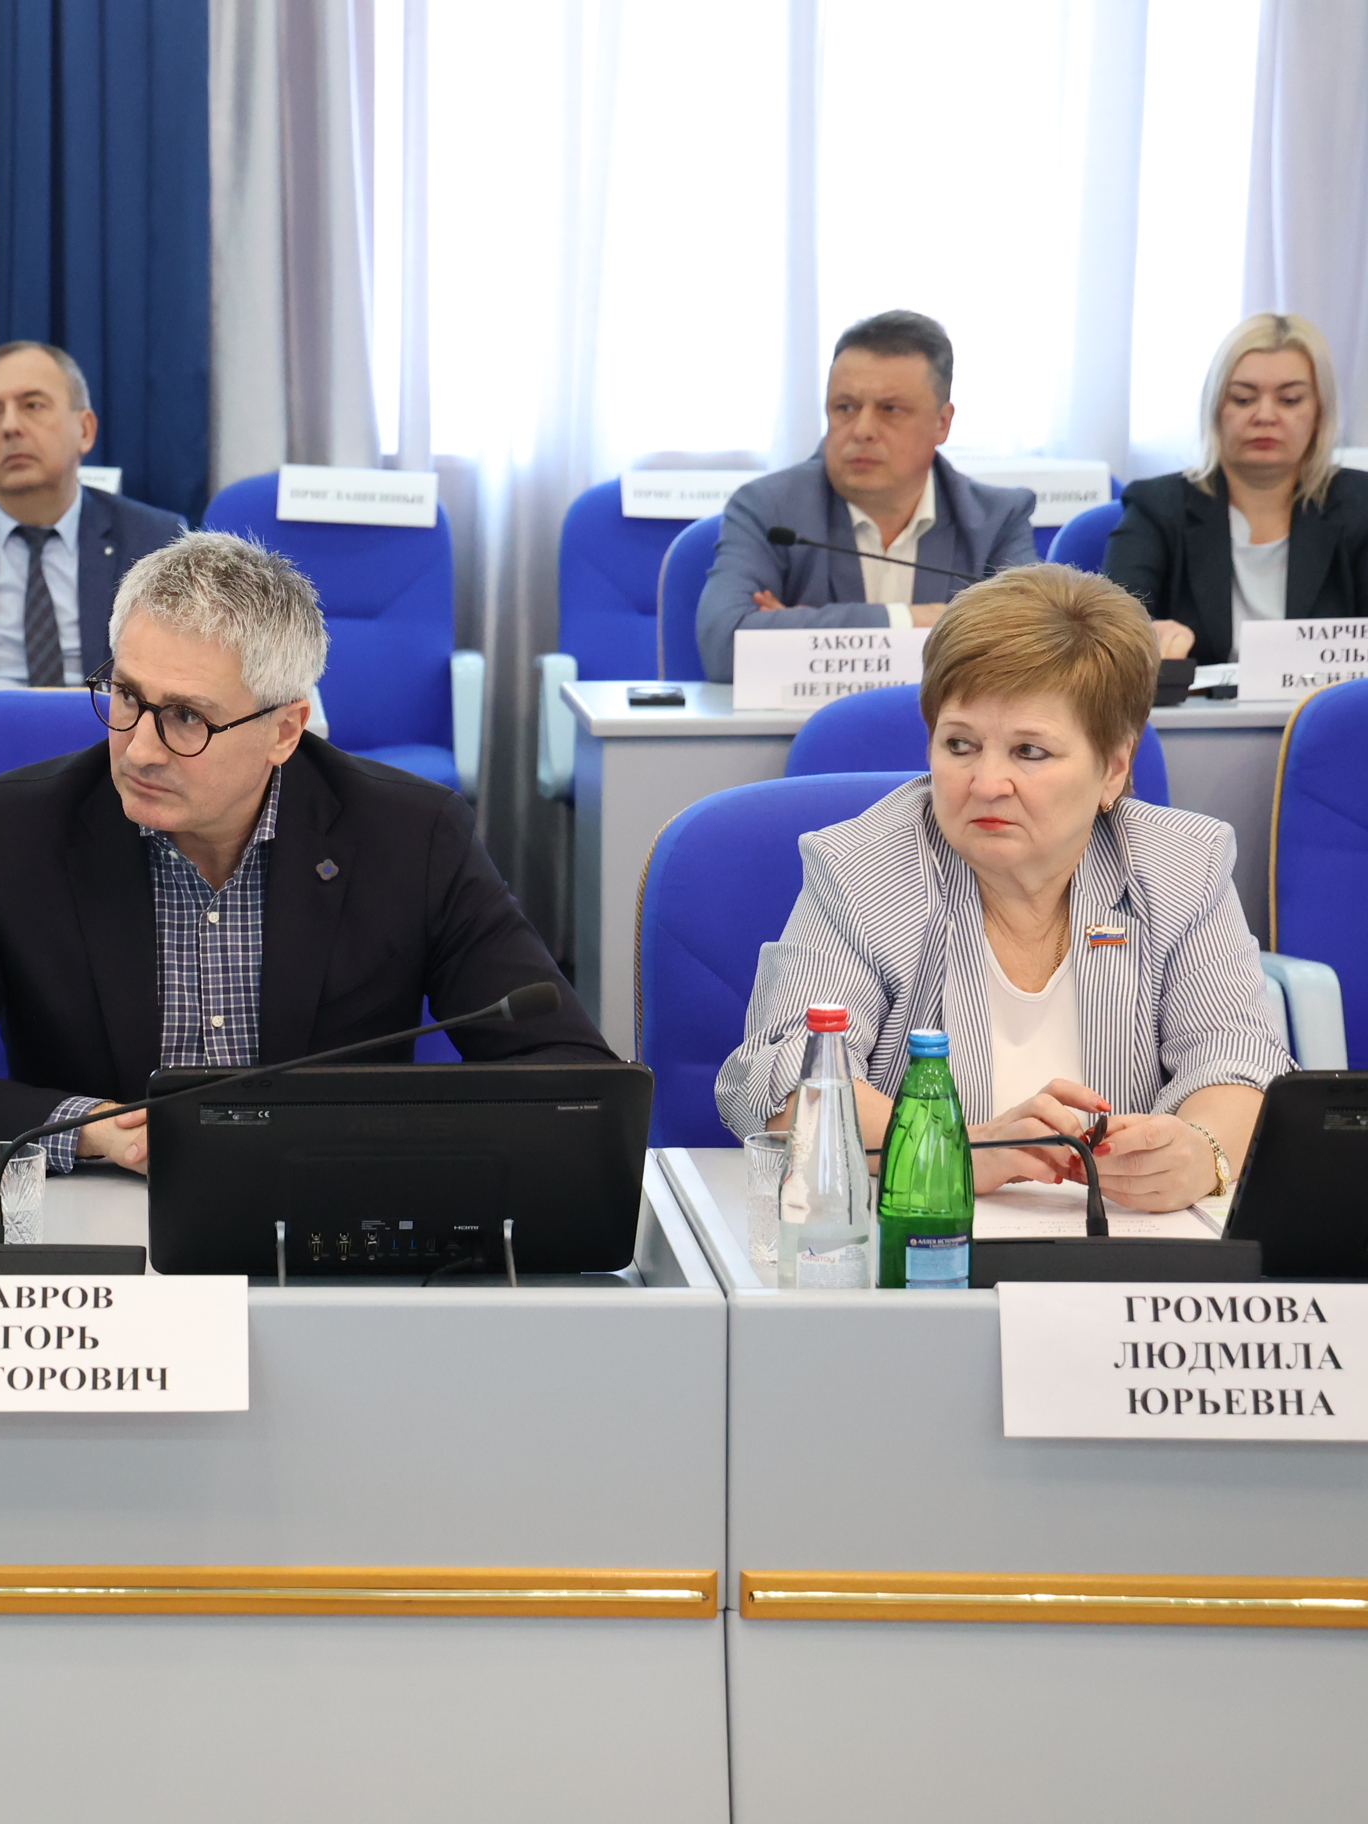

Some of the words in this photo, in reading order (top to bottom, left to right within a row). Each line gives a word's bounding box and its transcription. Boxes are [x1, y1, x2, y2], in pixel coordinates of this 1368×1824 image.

[810, 635, 892, 650] ЗАКОТА
[808, 654, 891, 673] СЕРГЕЙ
[1319, 647, 1368, 663] ОЛЬ
[1281, 671, 1368, 687] ВАСИ
[1124, 1296, 1328, 1324] ГРОМОВА
[1113, 1341, 1344, 1375] ЛЮДМИЛА
[1126, 1387, 1336, 1417] ЮРЬЕВНА
